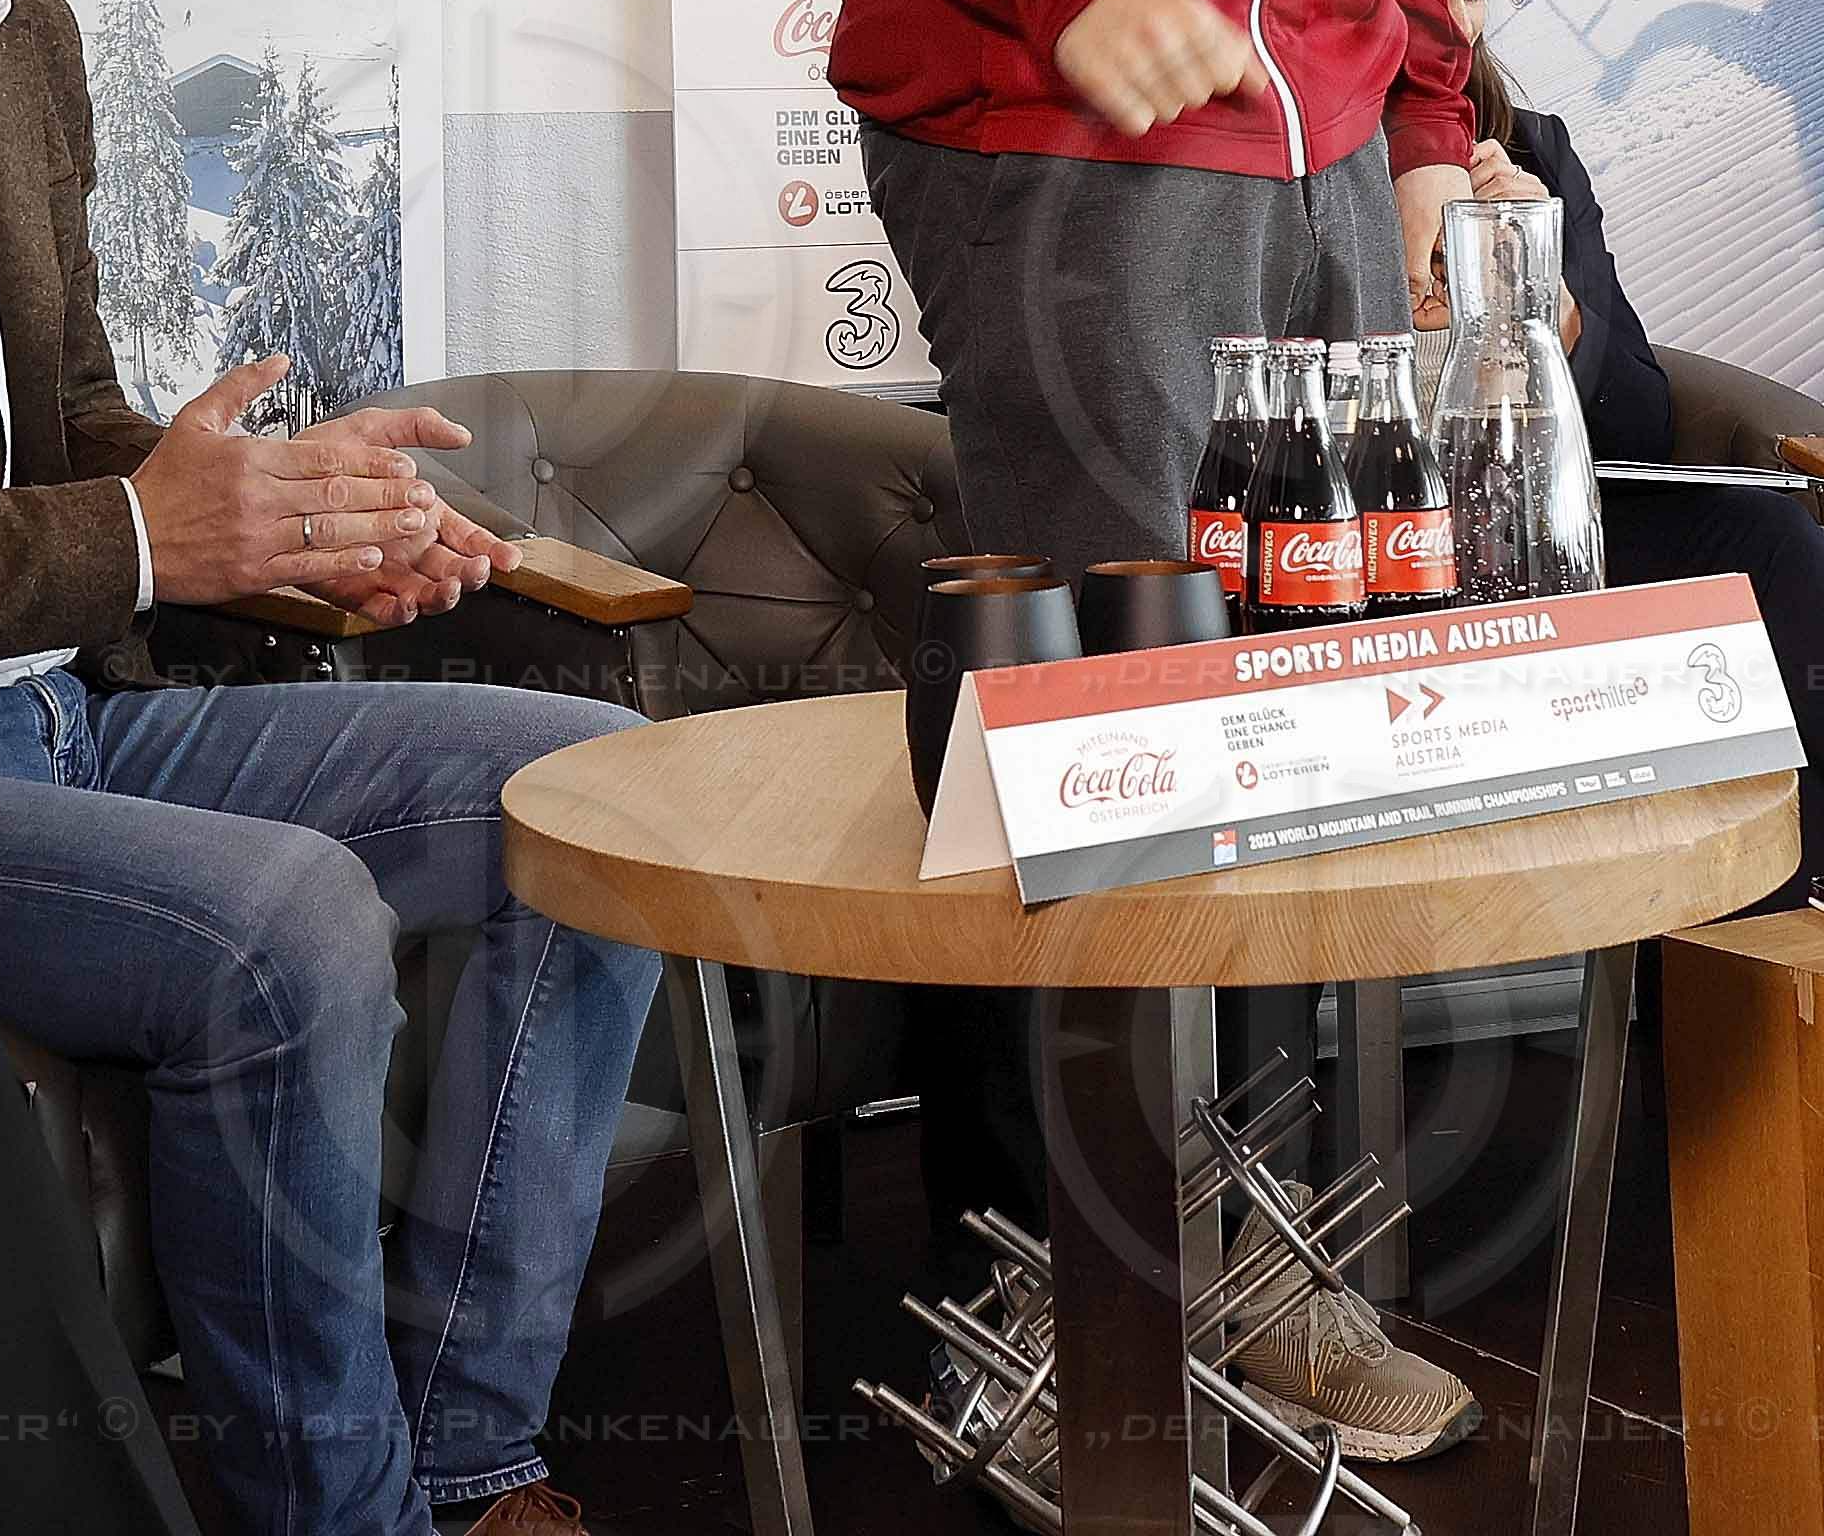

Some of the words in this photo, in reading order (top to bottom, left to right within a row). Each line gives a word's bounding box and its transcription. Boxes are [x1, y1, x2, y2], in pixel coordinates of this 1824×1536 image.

[776, 111, 818, 126] DEM
[776, 130, 819, 146] EINE
[777, 149, 840, 164] GEBEN
[1263, 530, 1273, 595] MEHRWEG
[1234, 639, 1343, 682] SPORTS
[1352, 629, 1439, 666] MEDIA
[1447, 613, 1558, 653] AUSTRIA
[1221, 713, 1248, 727] DEM
[1250, 707, 1286, 723] GLÜCK
[1225, 726, 1250, 739] EINE
[1252, 719, 1297, 735] CHANCE
[1391, 726, 1452, 748] SPORTS
[1459, 720, 1509, 738] MEDIA
[1227, 739, 1264, 751] GEBEN
[1395, 746, 1462, 768] AUSTRIA
[1262, 763, 1330, 780] LOTTERIEN
[1248, 832, 1276, 850] 2023
[1276, 823, 1318, 846] WORLD
[1319, 815, 1377, 838] MOUNTAIN
[1378, 810, 1402, 828] AND
